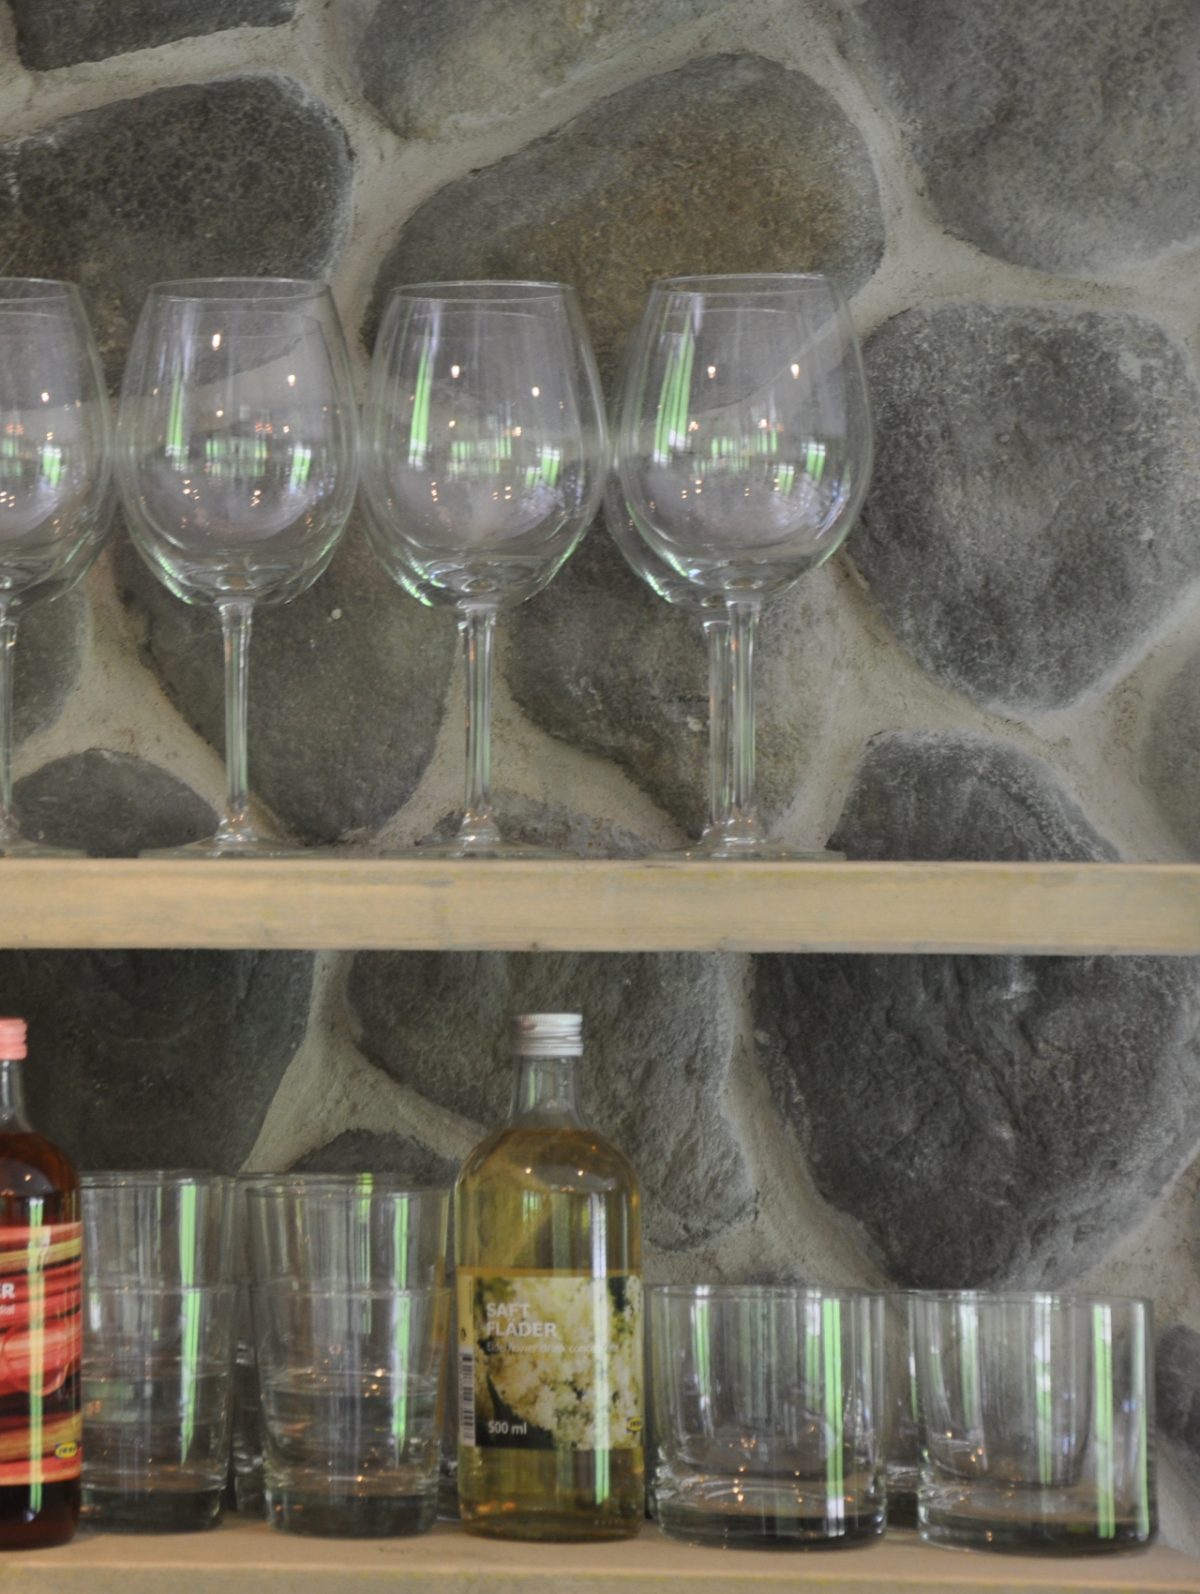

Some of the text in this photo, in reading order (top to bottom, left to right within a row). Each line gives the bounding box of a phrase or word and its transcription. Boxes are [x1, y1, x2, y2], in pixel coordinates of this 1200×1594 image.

[486, 1303, 530, 1318] SAFT
[486, 1319, 557, 1337] FLÄDER
[488, 1421, 527, 1435] 500 ml
